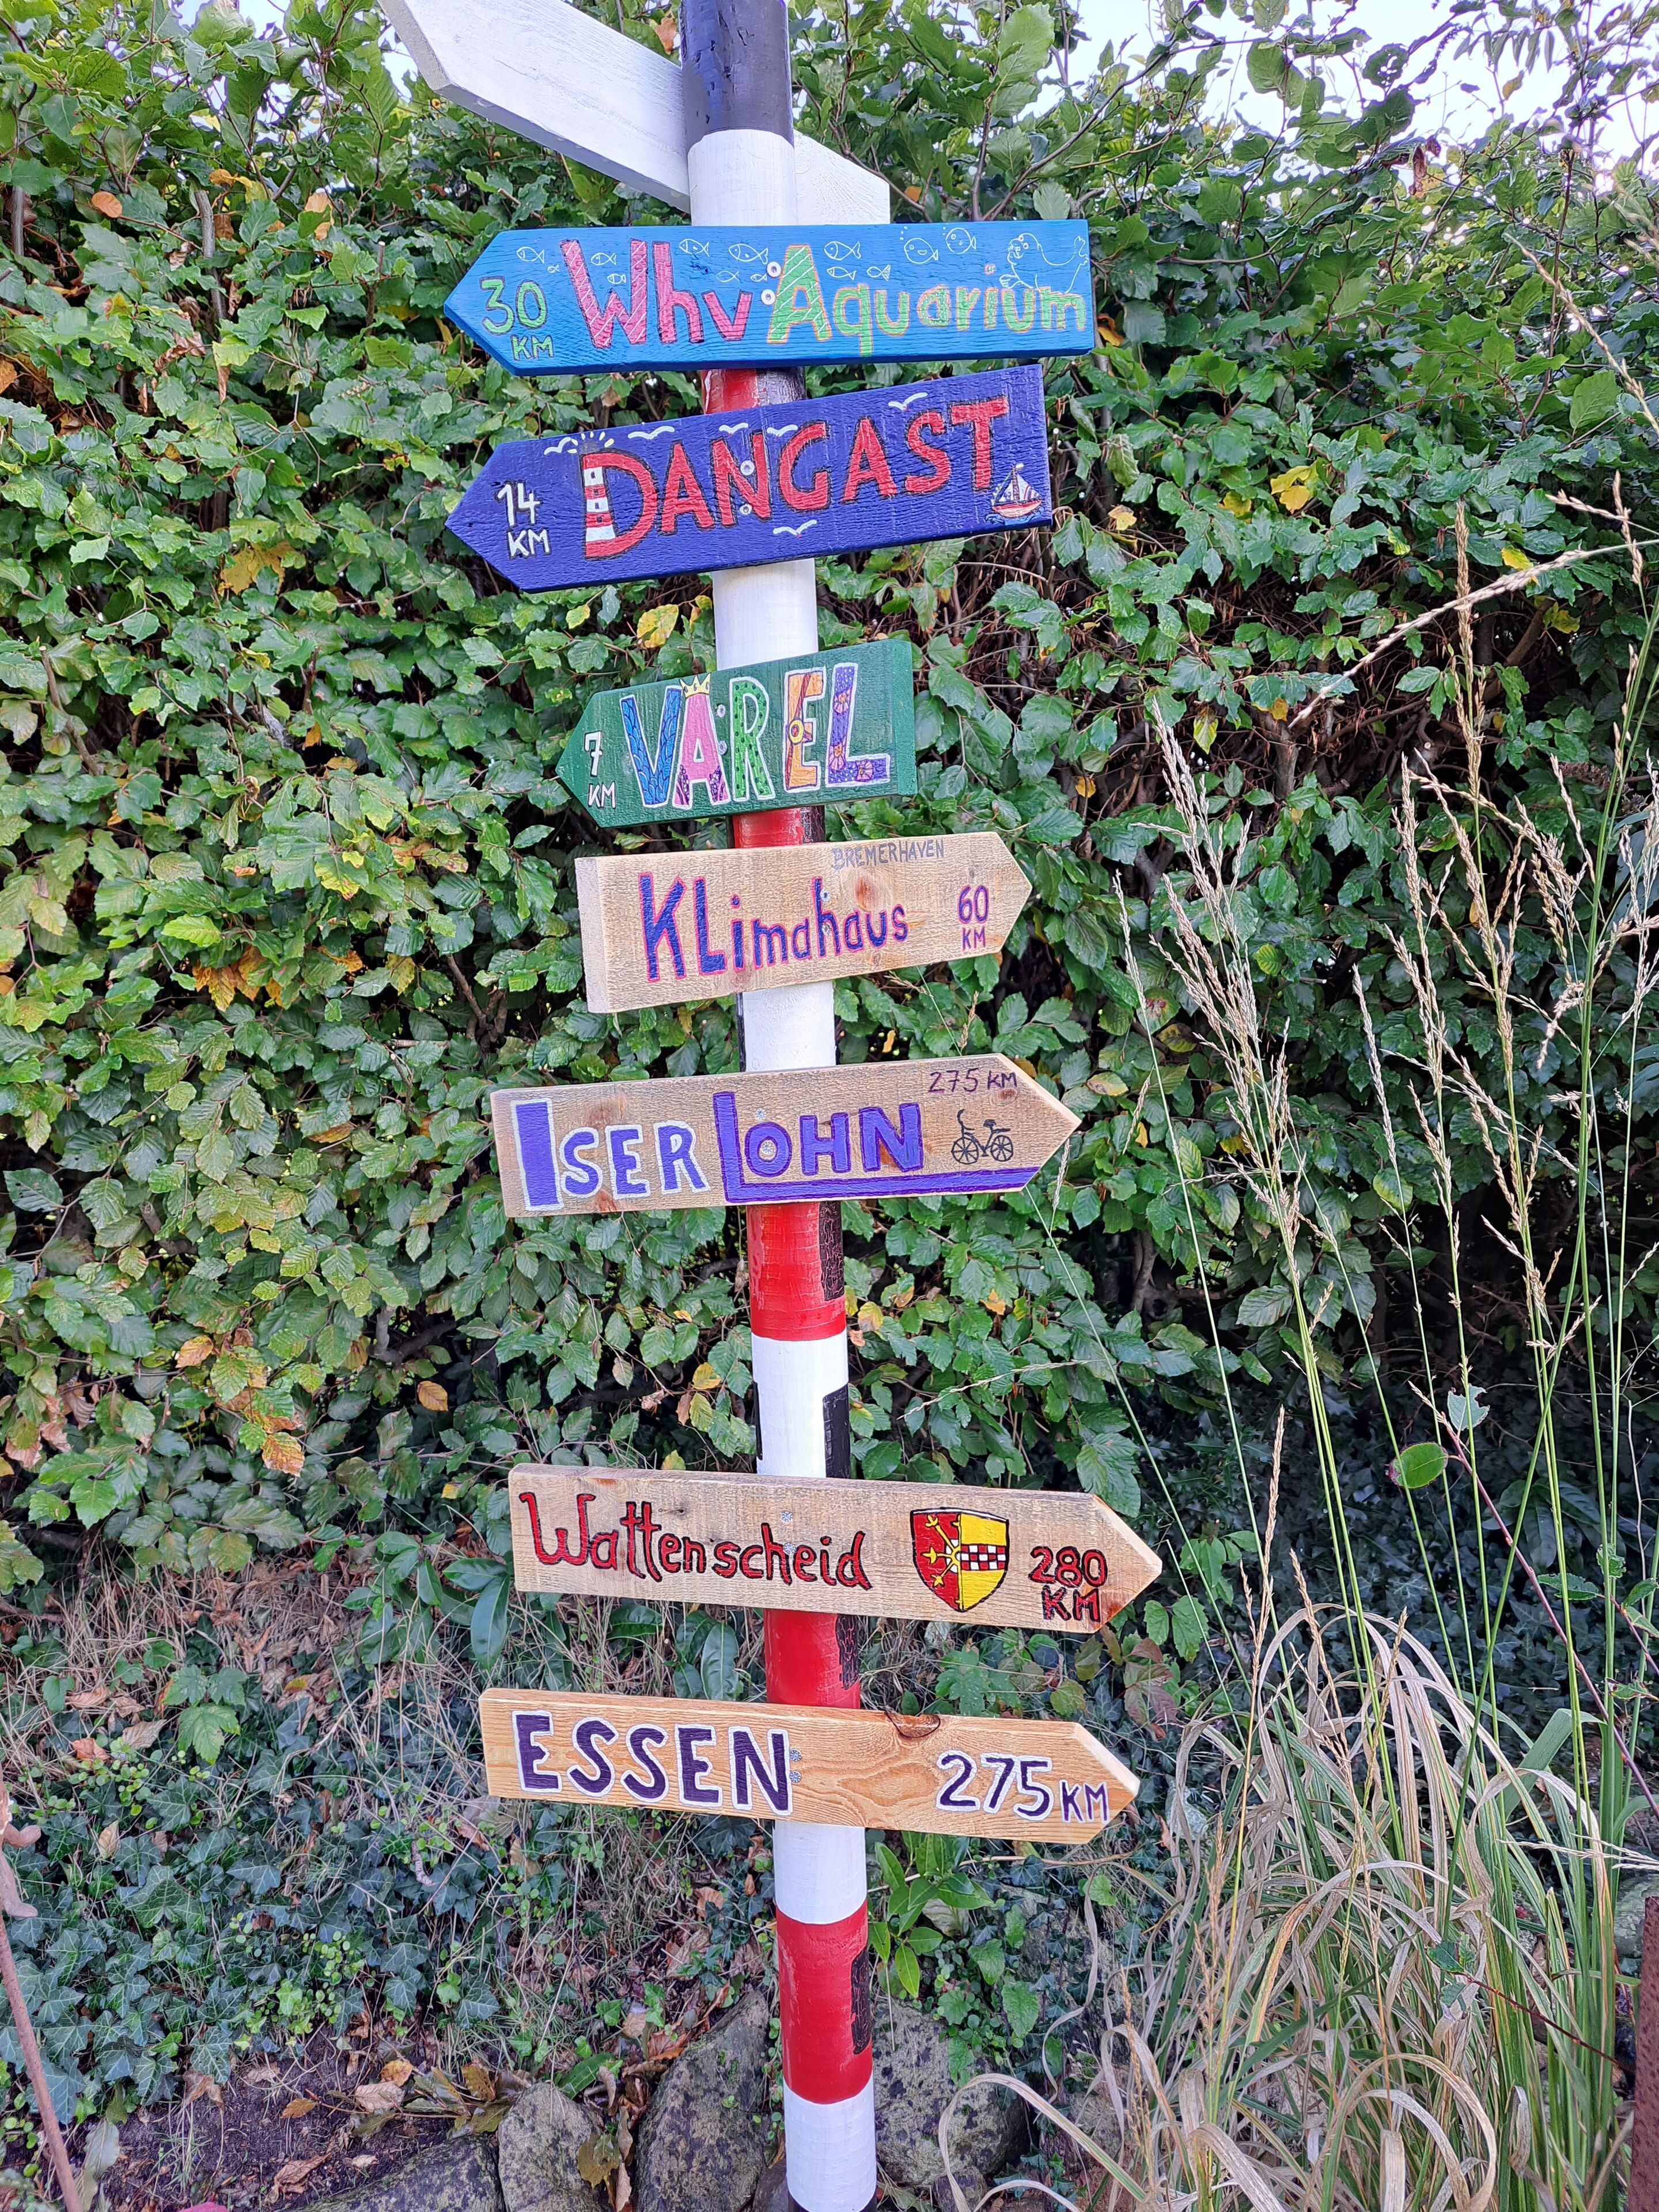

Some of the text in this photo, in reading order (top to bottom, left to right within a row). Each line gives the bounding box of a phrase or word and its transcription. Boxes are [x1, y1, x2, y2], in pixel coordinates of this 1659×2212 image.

[479, 275, 548, 335] 30
[559, 238, 1086, 357] Whv Aquarium
[510, 334, 554, 362] KM
[581, 395, 1010, 560] DANGAST
[496, 479, 543, 527] 14
[507, 528, 551, 559] KM
[584, 730, 604, 777] 7
[619, 662, 891, 809] VAREL
[588, 780, 616, 809] KM
[831, 839, 945, 870] BREMERHAVEN
[957, 885, 990, 924] 60
[961, 927, 987, 952] KM
[928, 1067, 1017, 1093] 275 KM
[518, 1492, 873, 1590] Wattenscheid
[1028, 1546, 1108, 1588] 280
[1041, 1585, 1101, 1623] KM
[512, 1710, 793, 1816] ESSEN
[935, 1750, 1110, 1824] 275 KM
